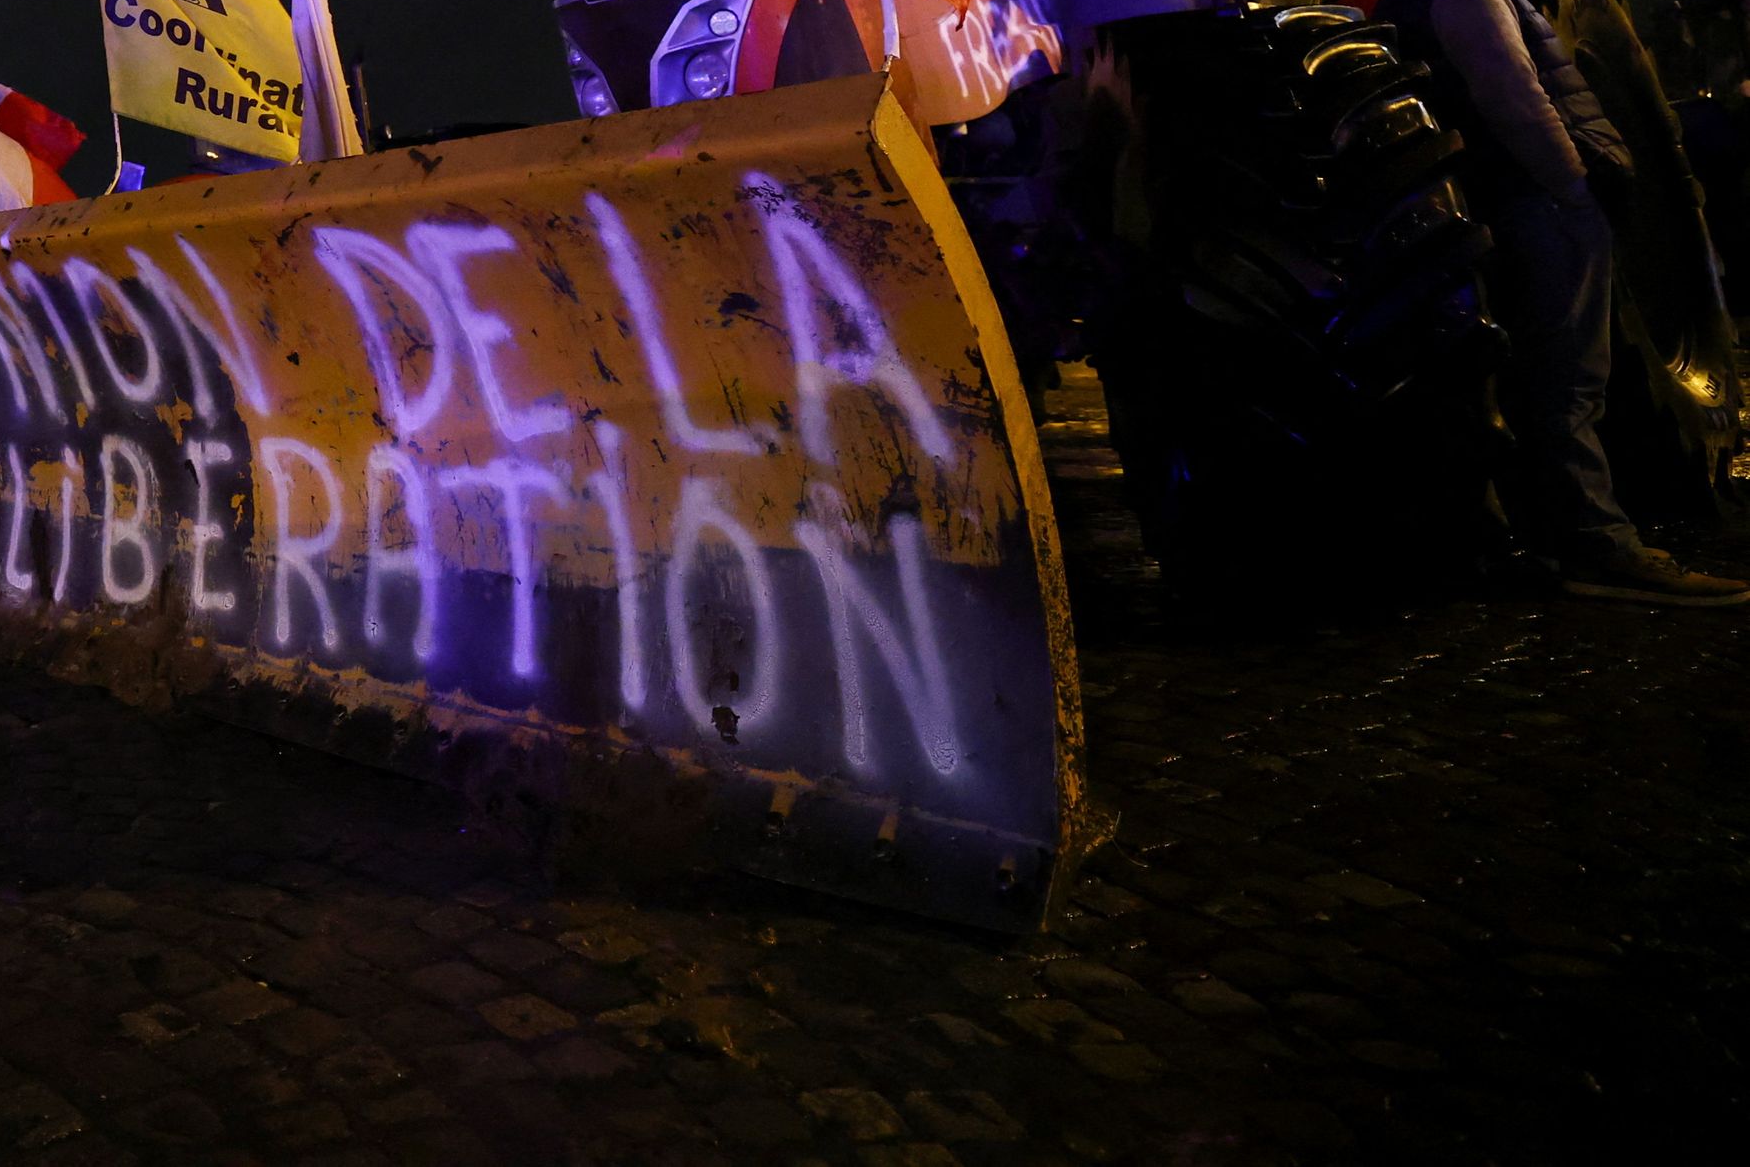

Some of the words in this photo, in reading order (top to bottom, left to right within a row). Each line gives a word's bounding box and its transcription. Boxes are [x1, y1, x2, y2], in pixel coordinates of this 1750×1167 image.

[174, 67, 295, 138] Rura
[312, 222, 572, 442] DE
[583, 170, 956, 465] LA
